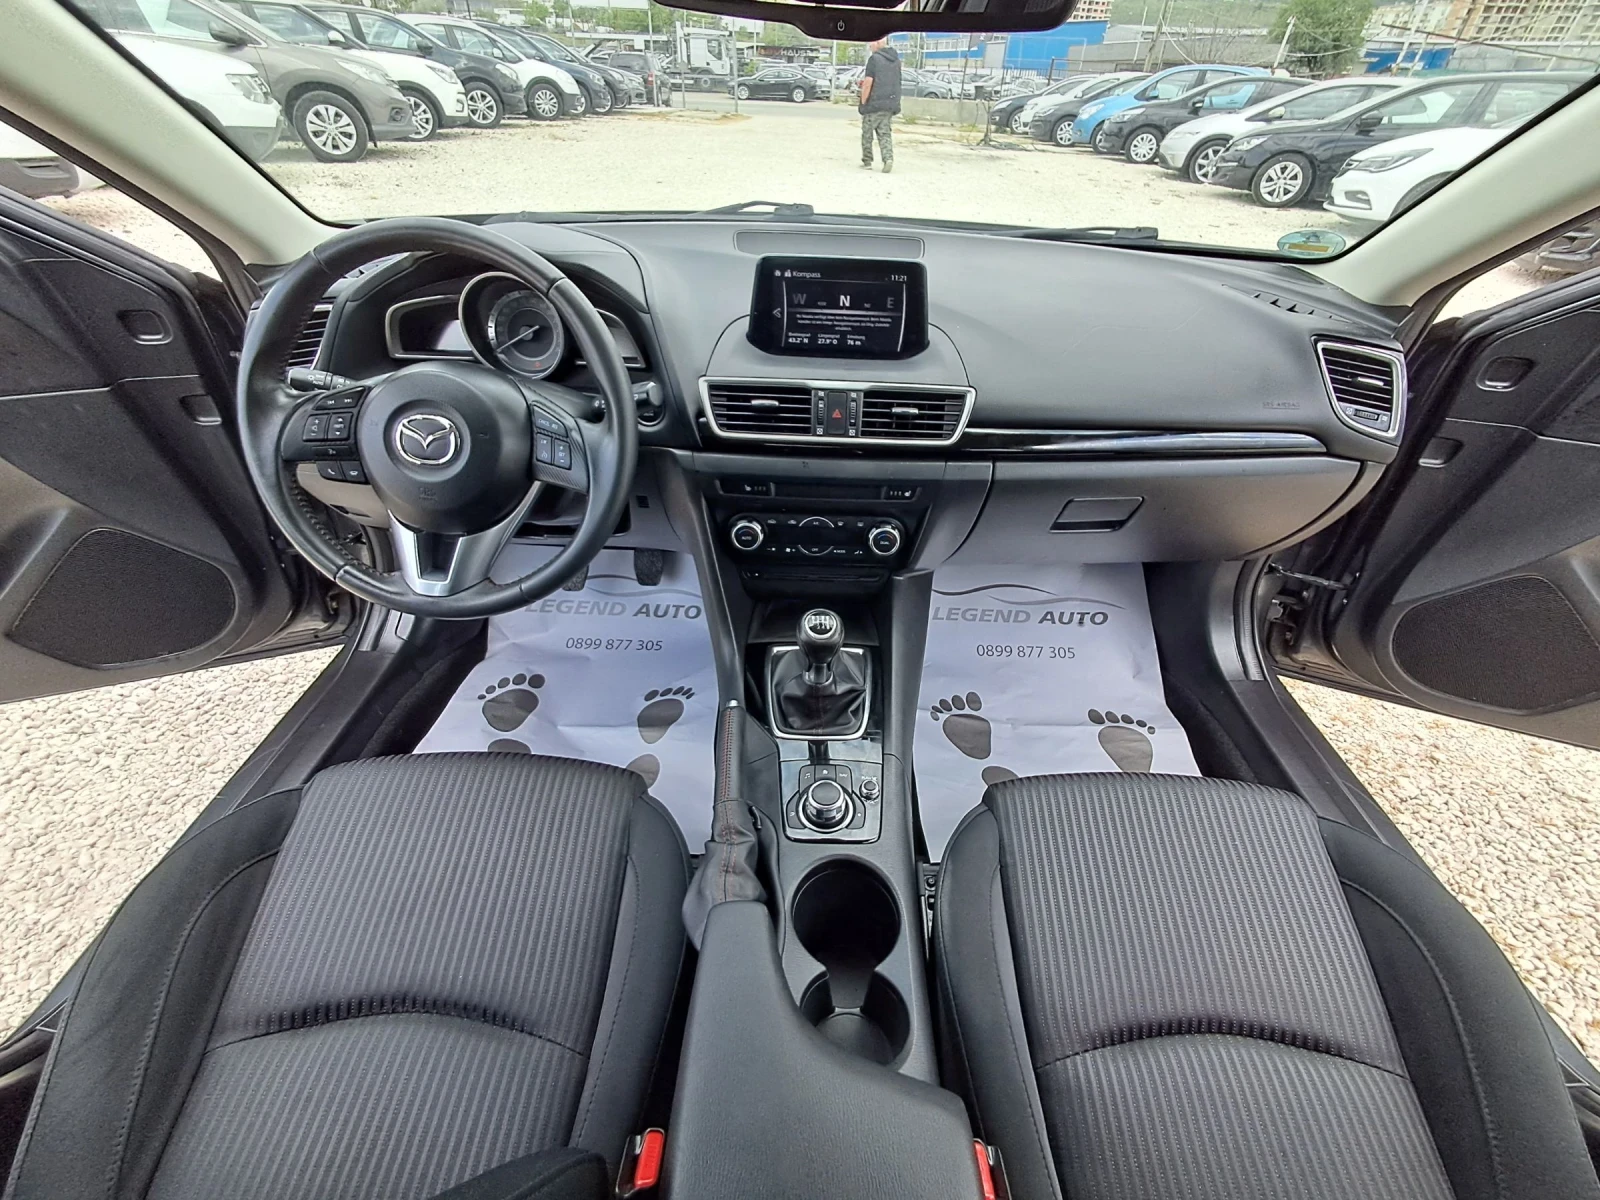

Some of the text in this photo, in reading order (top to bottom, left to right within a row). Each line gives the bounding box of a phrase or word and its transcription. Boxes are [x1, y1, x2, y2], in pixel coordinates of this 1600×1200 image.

[792, 270, 821, 279] Kompass
[890, 274, 908, 282] 11:21
[793, 293, 807, 305] W
[839, 295, 851, 307] N
[886, 297, 895, 309] E
[525, 599, 702, 619] LEGEND AUTO
[932, 606, 1109, 626] LEGEND AUTO
[566, 637, 663, 651] 0899 877 305
[976, 644, 1076, 659] 0899 877 305
